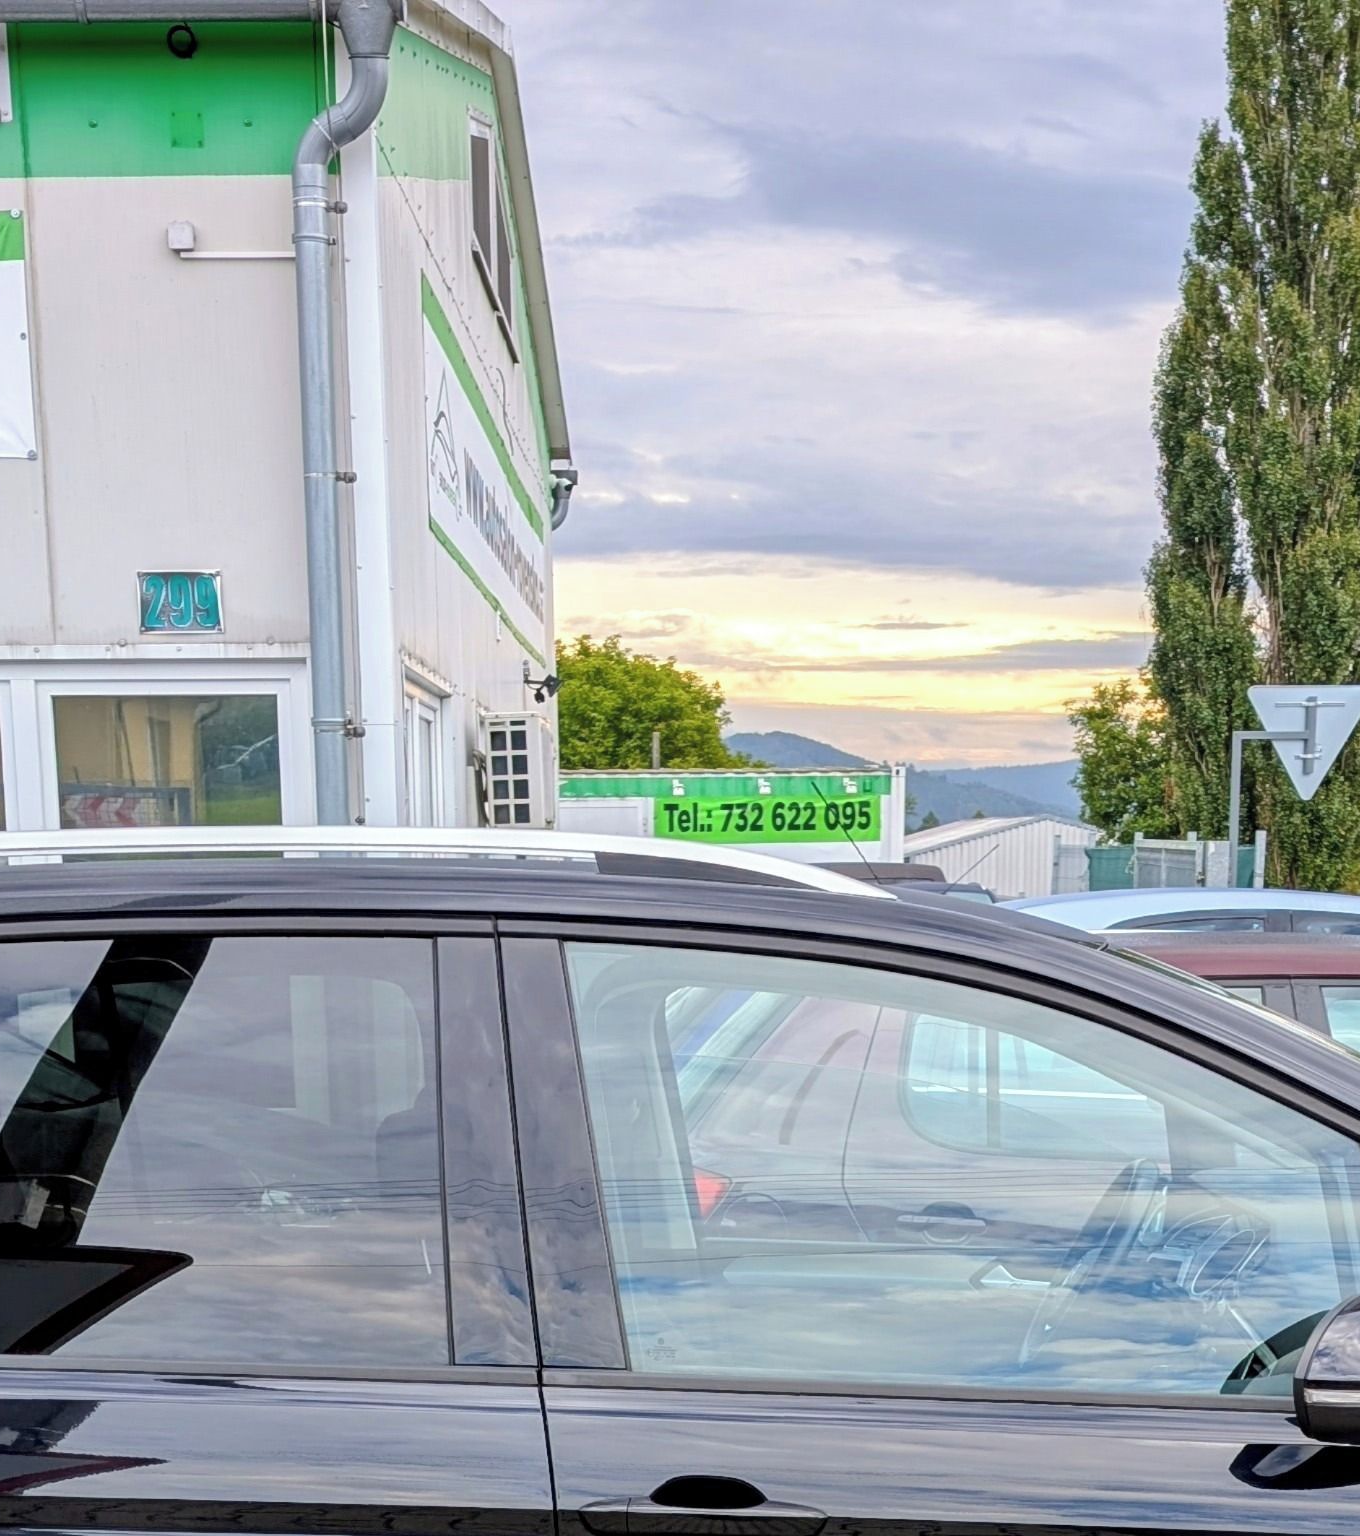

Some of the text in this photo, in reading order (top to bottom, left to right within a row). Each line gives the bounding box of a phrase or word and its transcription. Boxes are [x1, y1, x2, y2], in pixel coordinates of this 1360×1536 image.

[143, 574, 219, 628] 299
[664, 801, 872, 832] Tel.: 732 622 095
